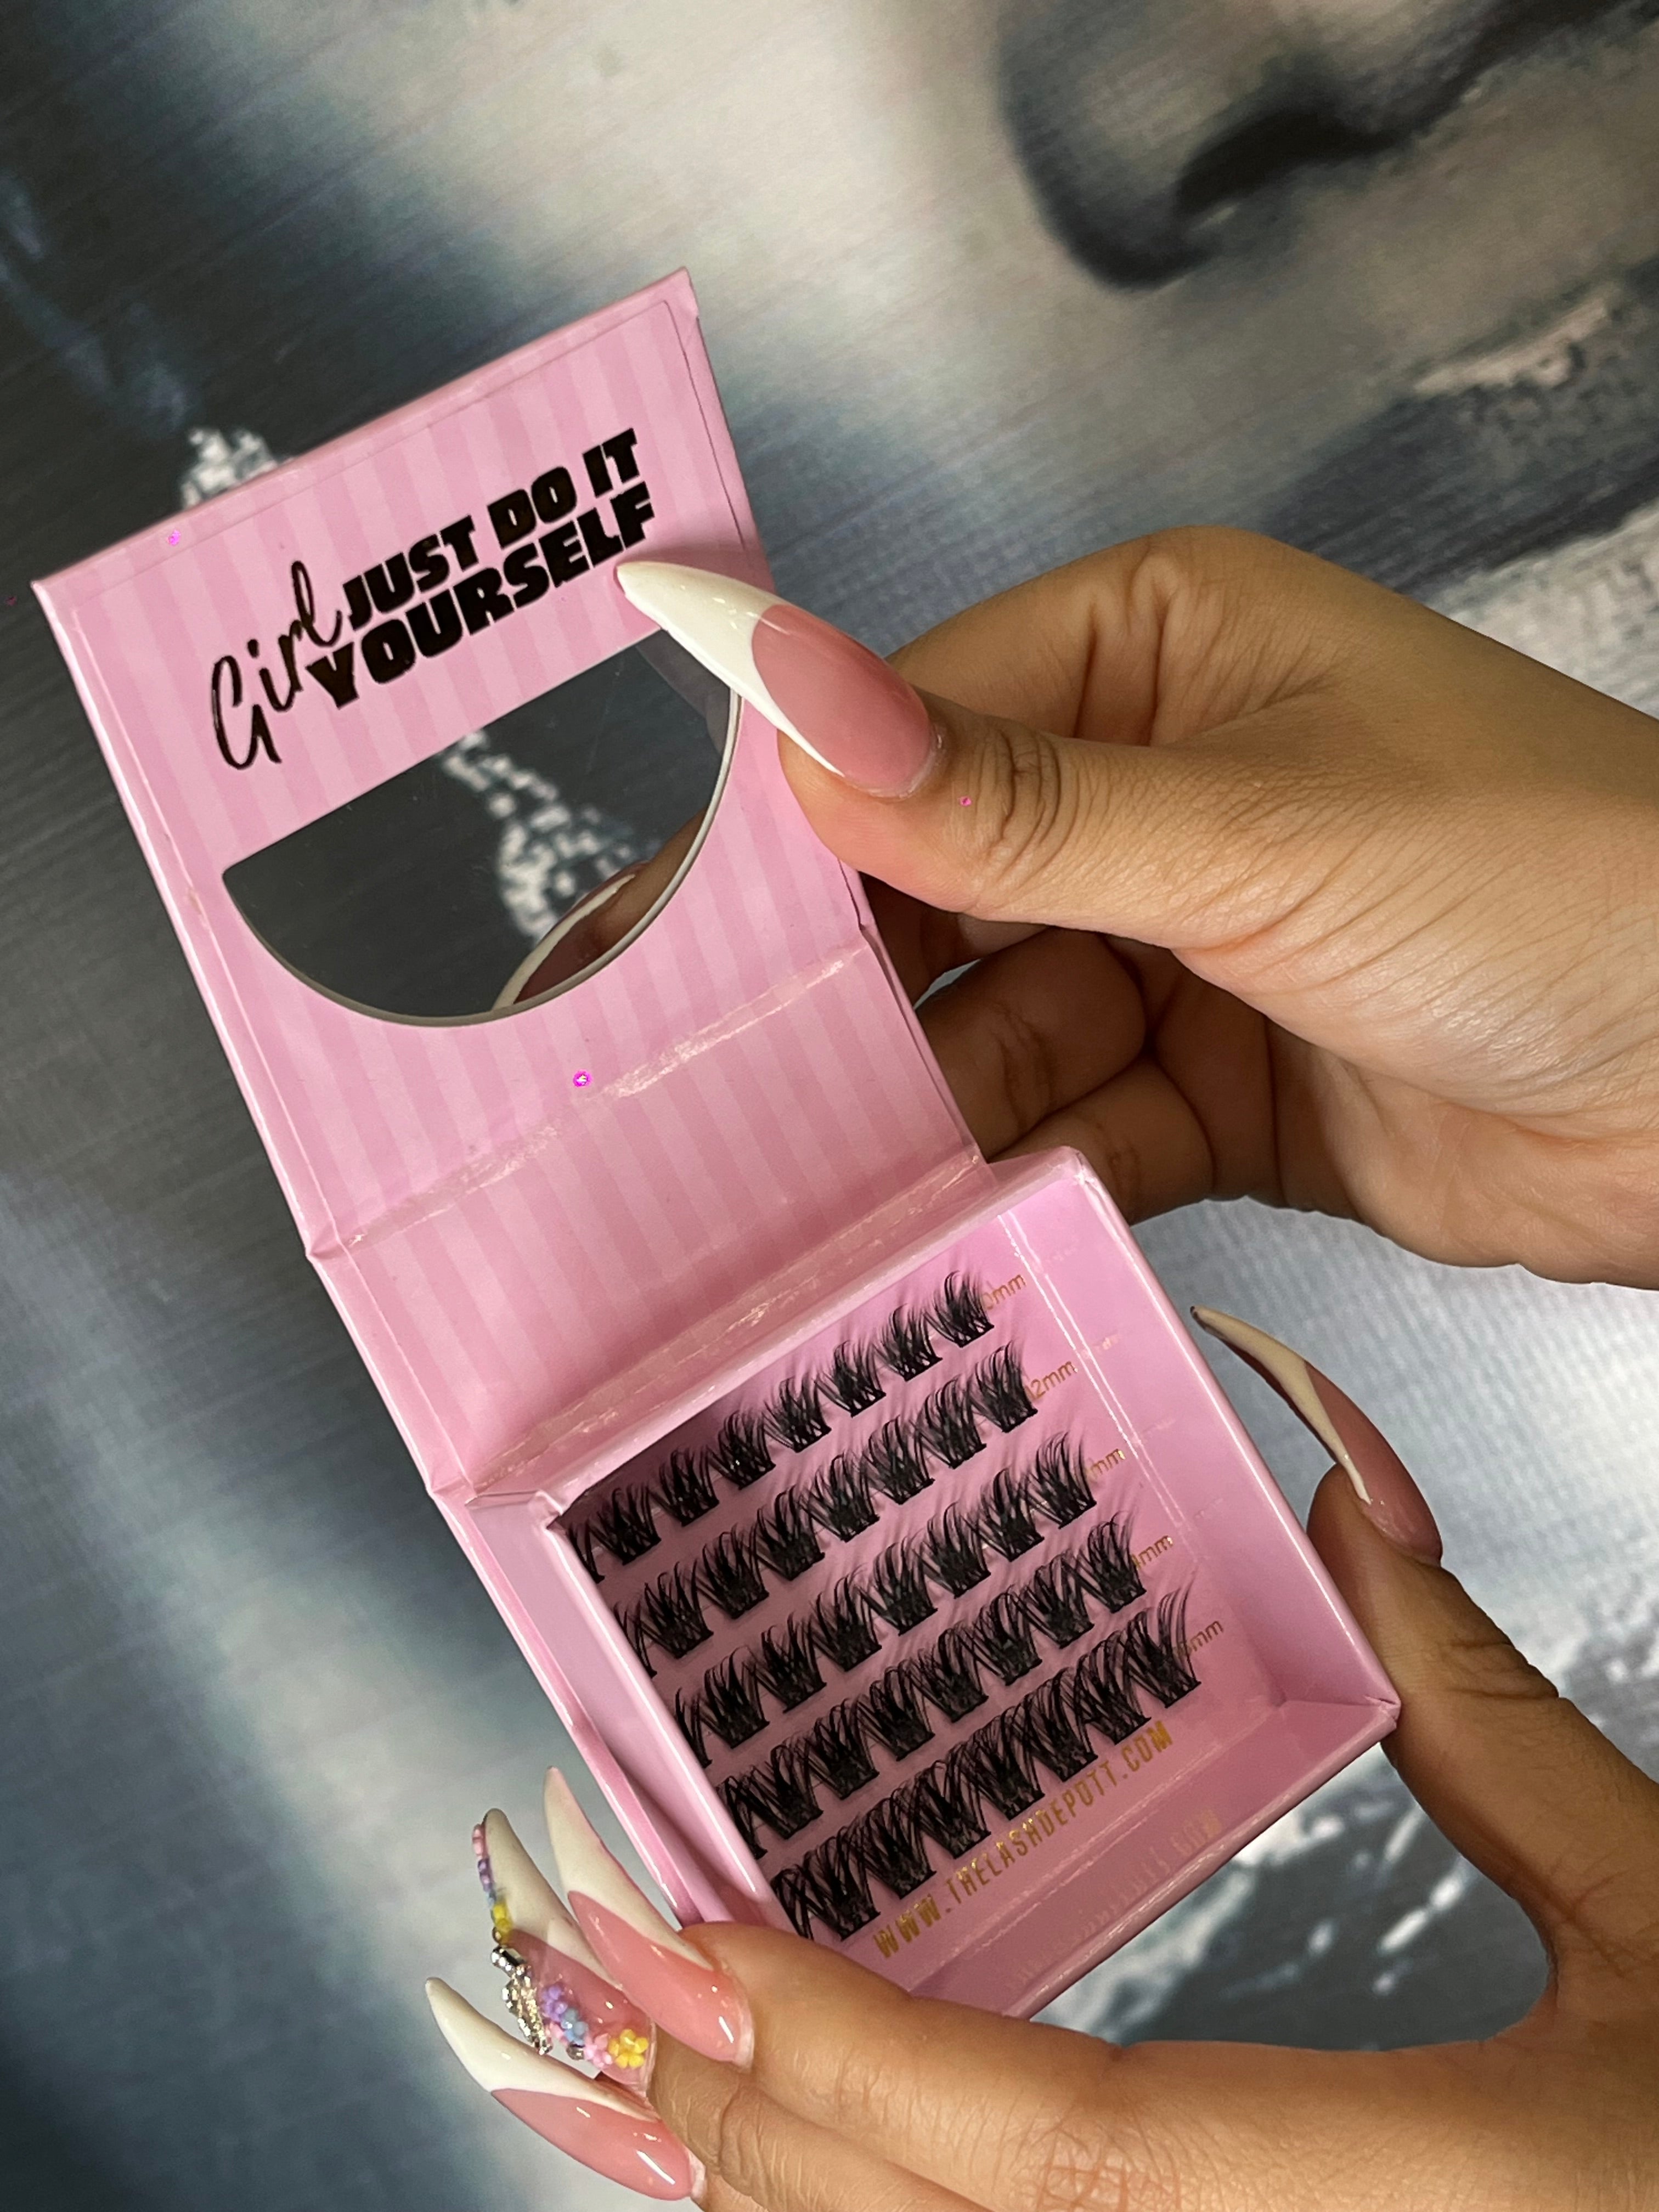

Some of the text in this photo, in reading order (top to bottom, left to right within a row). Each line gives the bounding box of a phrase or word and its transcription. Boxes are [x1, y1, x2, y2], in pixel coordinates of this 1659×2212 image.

[211, 428, 640, 770] Girl JUST DO IT
[305, 481, 654, 708] YOURSELF
